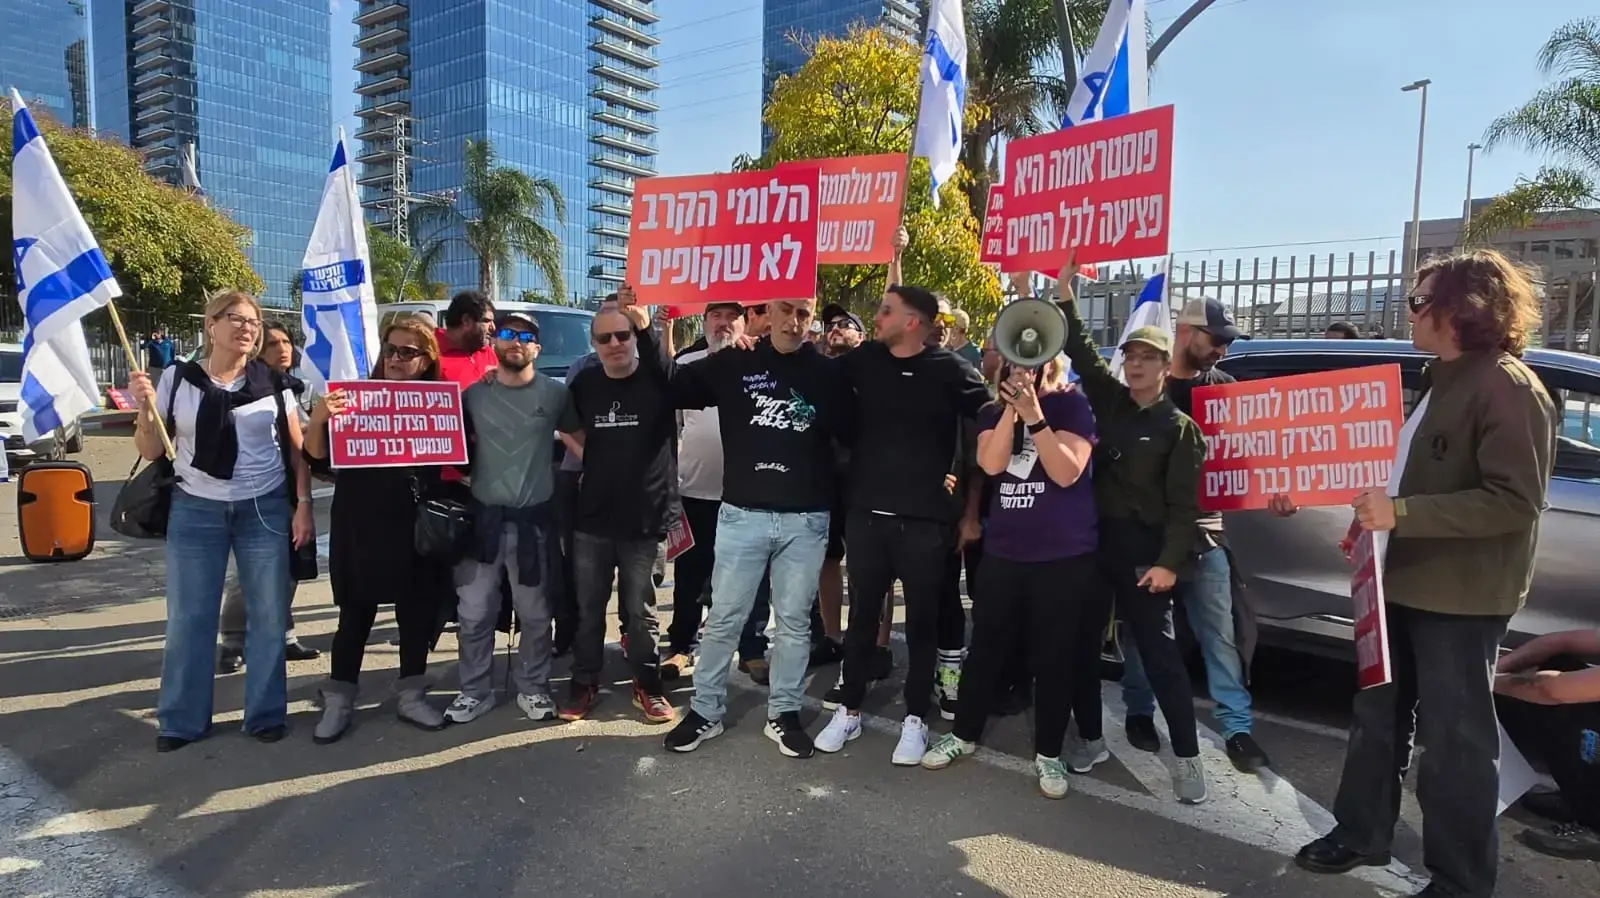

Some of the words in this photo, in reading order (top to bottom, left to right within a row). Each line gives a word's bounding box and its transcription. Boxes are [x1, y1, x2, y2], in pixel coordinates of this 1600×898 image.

[1014, 153, 1045, 198] היא
[1048, 129, 1158, 191] פוסטראומה
[726, 178, 810, 225] הלומי
[875, 171, 898, 203] נכי
[638, 189, 718, 236] הקרב
[1059, 197, 1095, 249] לכל
[1099, 194, 1163, 247] פציעה
[841, 220, 875, 252] נפש
[1006, 211, 1055, 257] החיים
[639, 243, 751, 291] שקופים
[758, 233, 802, 282] לא
[360, 387, 391, 411] לתקן
[394, 390, 423, 410] הזמן
[425, 391, 453, 409] הגיע
[1204, 397, 1231, 424] את
[1236, 386, 1282, 426] לתקן
[1288, 387, 1333, 421] הזמן
[1340, 381, 1387, 413] הגיע
[334, 411, 390, 432] והאפלייה
[393, 414, 428, 434] הצדק
[430, 414, 459, 431] חוסר
[1342, 420, 1394, 450] חוסר
[346, 438, 378, 457] שנים
[380, 438, 404, 456] כבר
[407, 437, 452, 458] שנמשך
[1281, 424, 1337, 460] הצדק
[1205, 469, 1248, 498] שנים
[1253, 467, 1290, 495] כבר
[1296, 460, 1393, 492] שנמשכים
